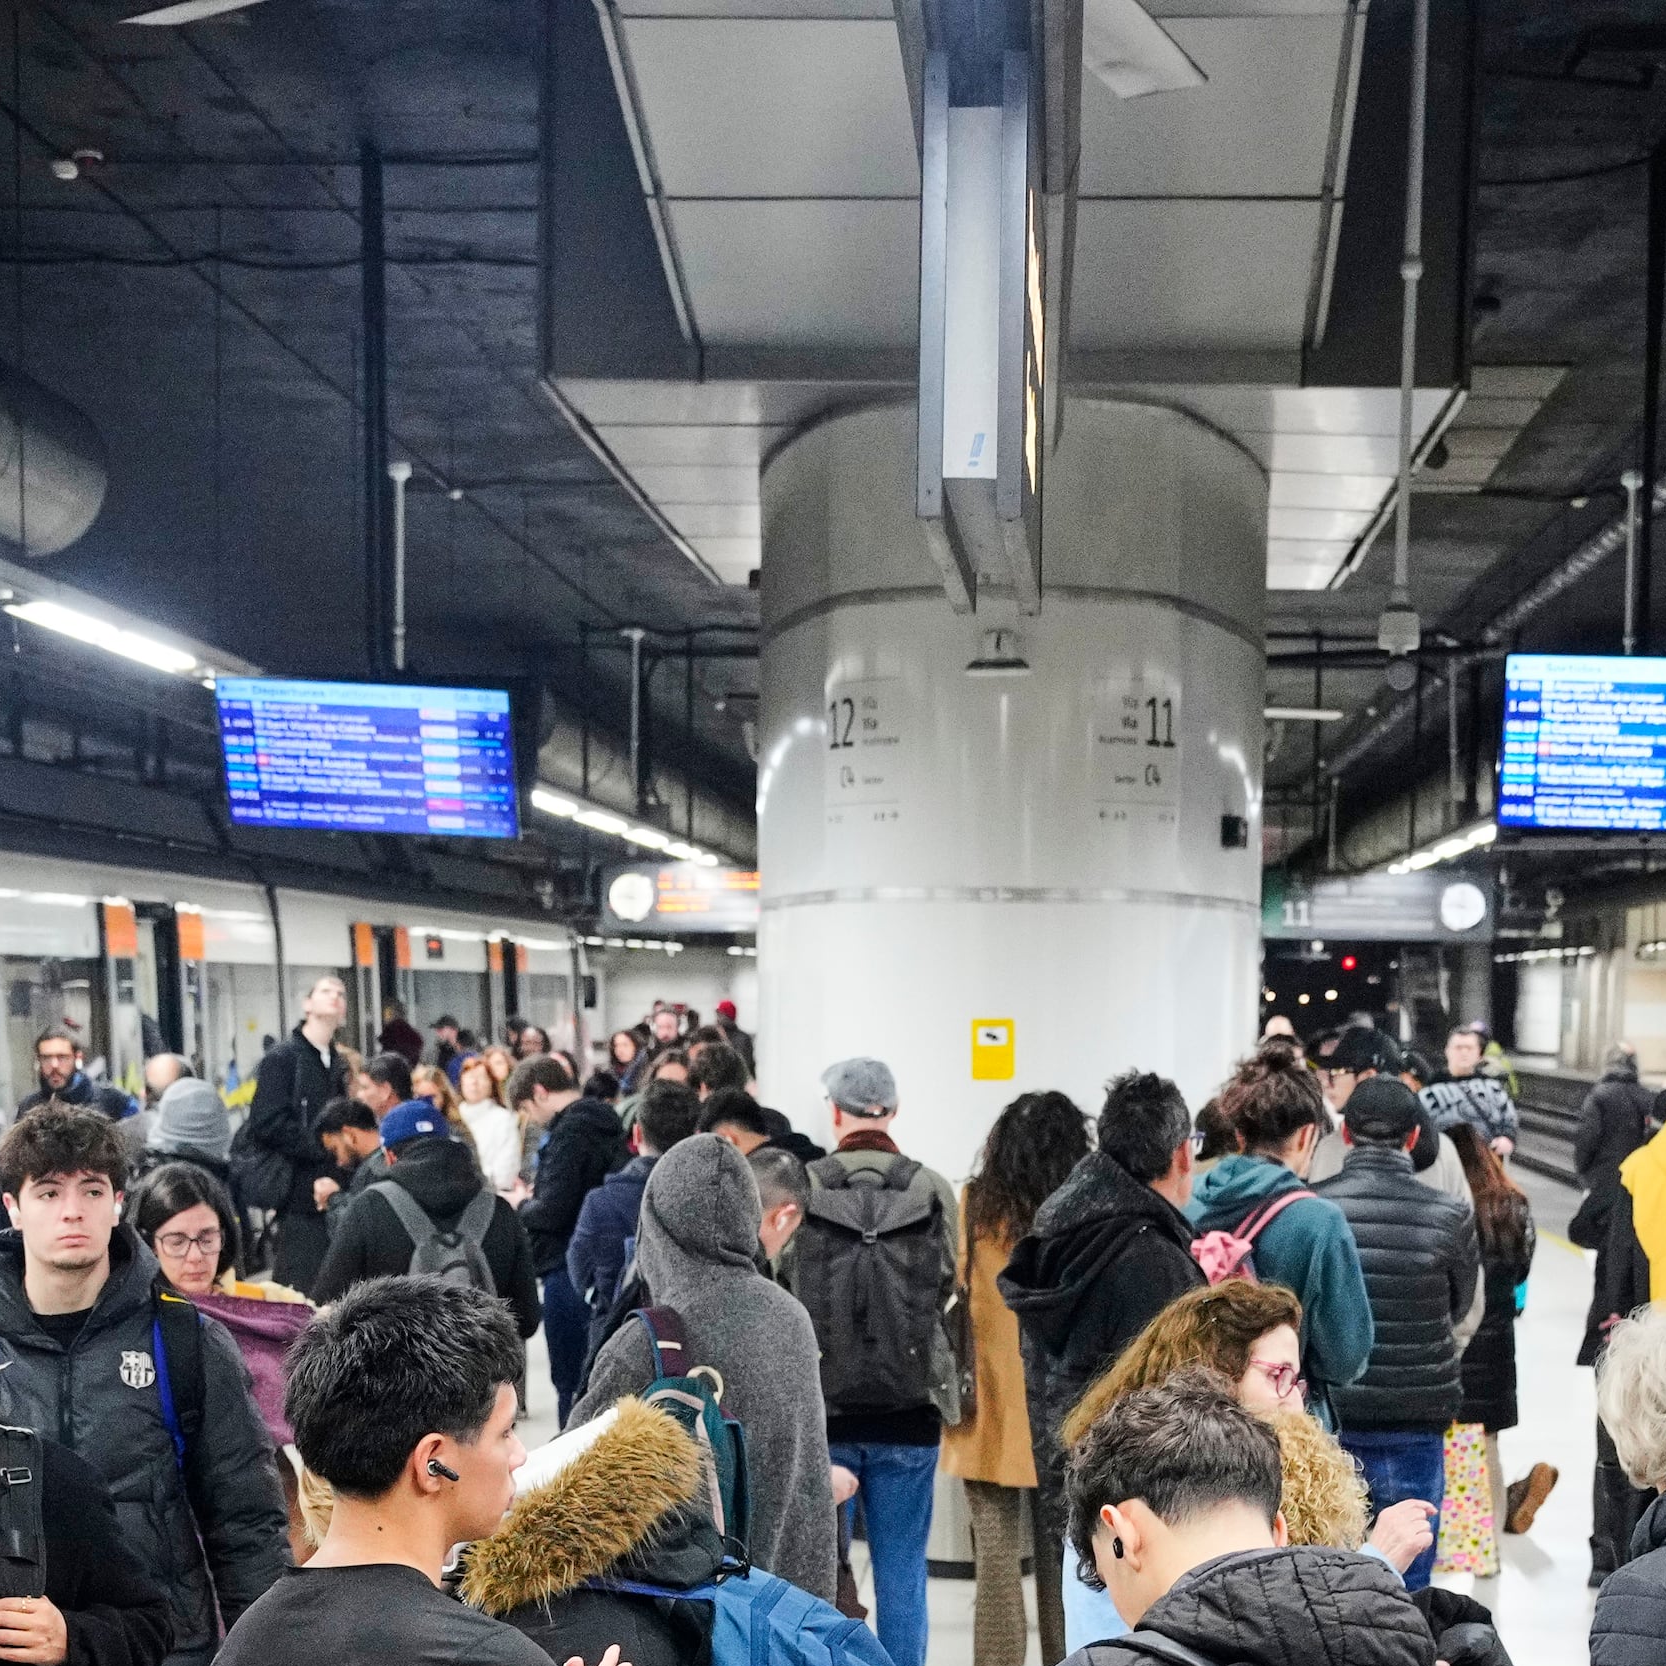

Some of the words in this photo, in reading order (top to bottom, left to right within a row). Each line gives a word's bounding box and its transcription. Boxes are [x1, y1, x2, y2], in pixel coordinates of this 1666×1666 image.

[829, 697, 855, 750] 12
[1145, 696, 1177, 749] 11
[1282, 899, 1310, 928] 11
